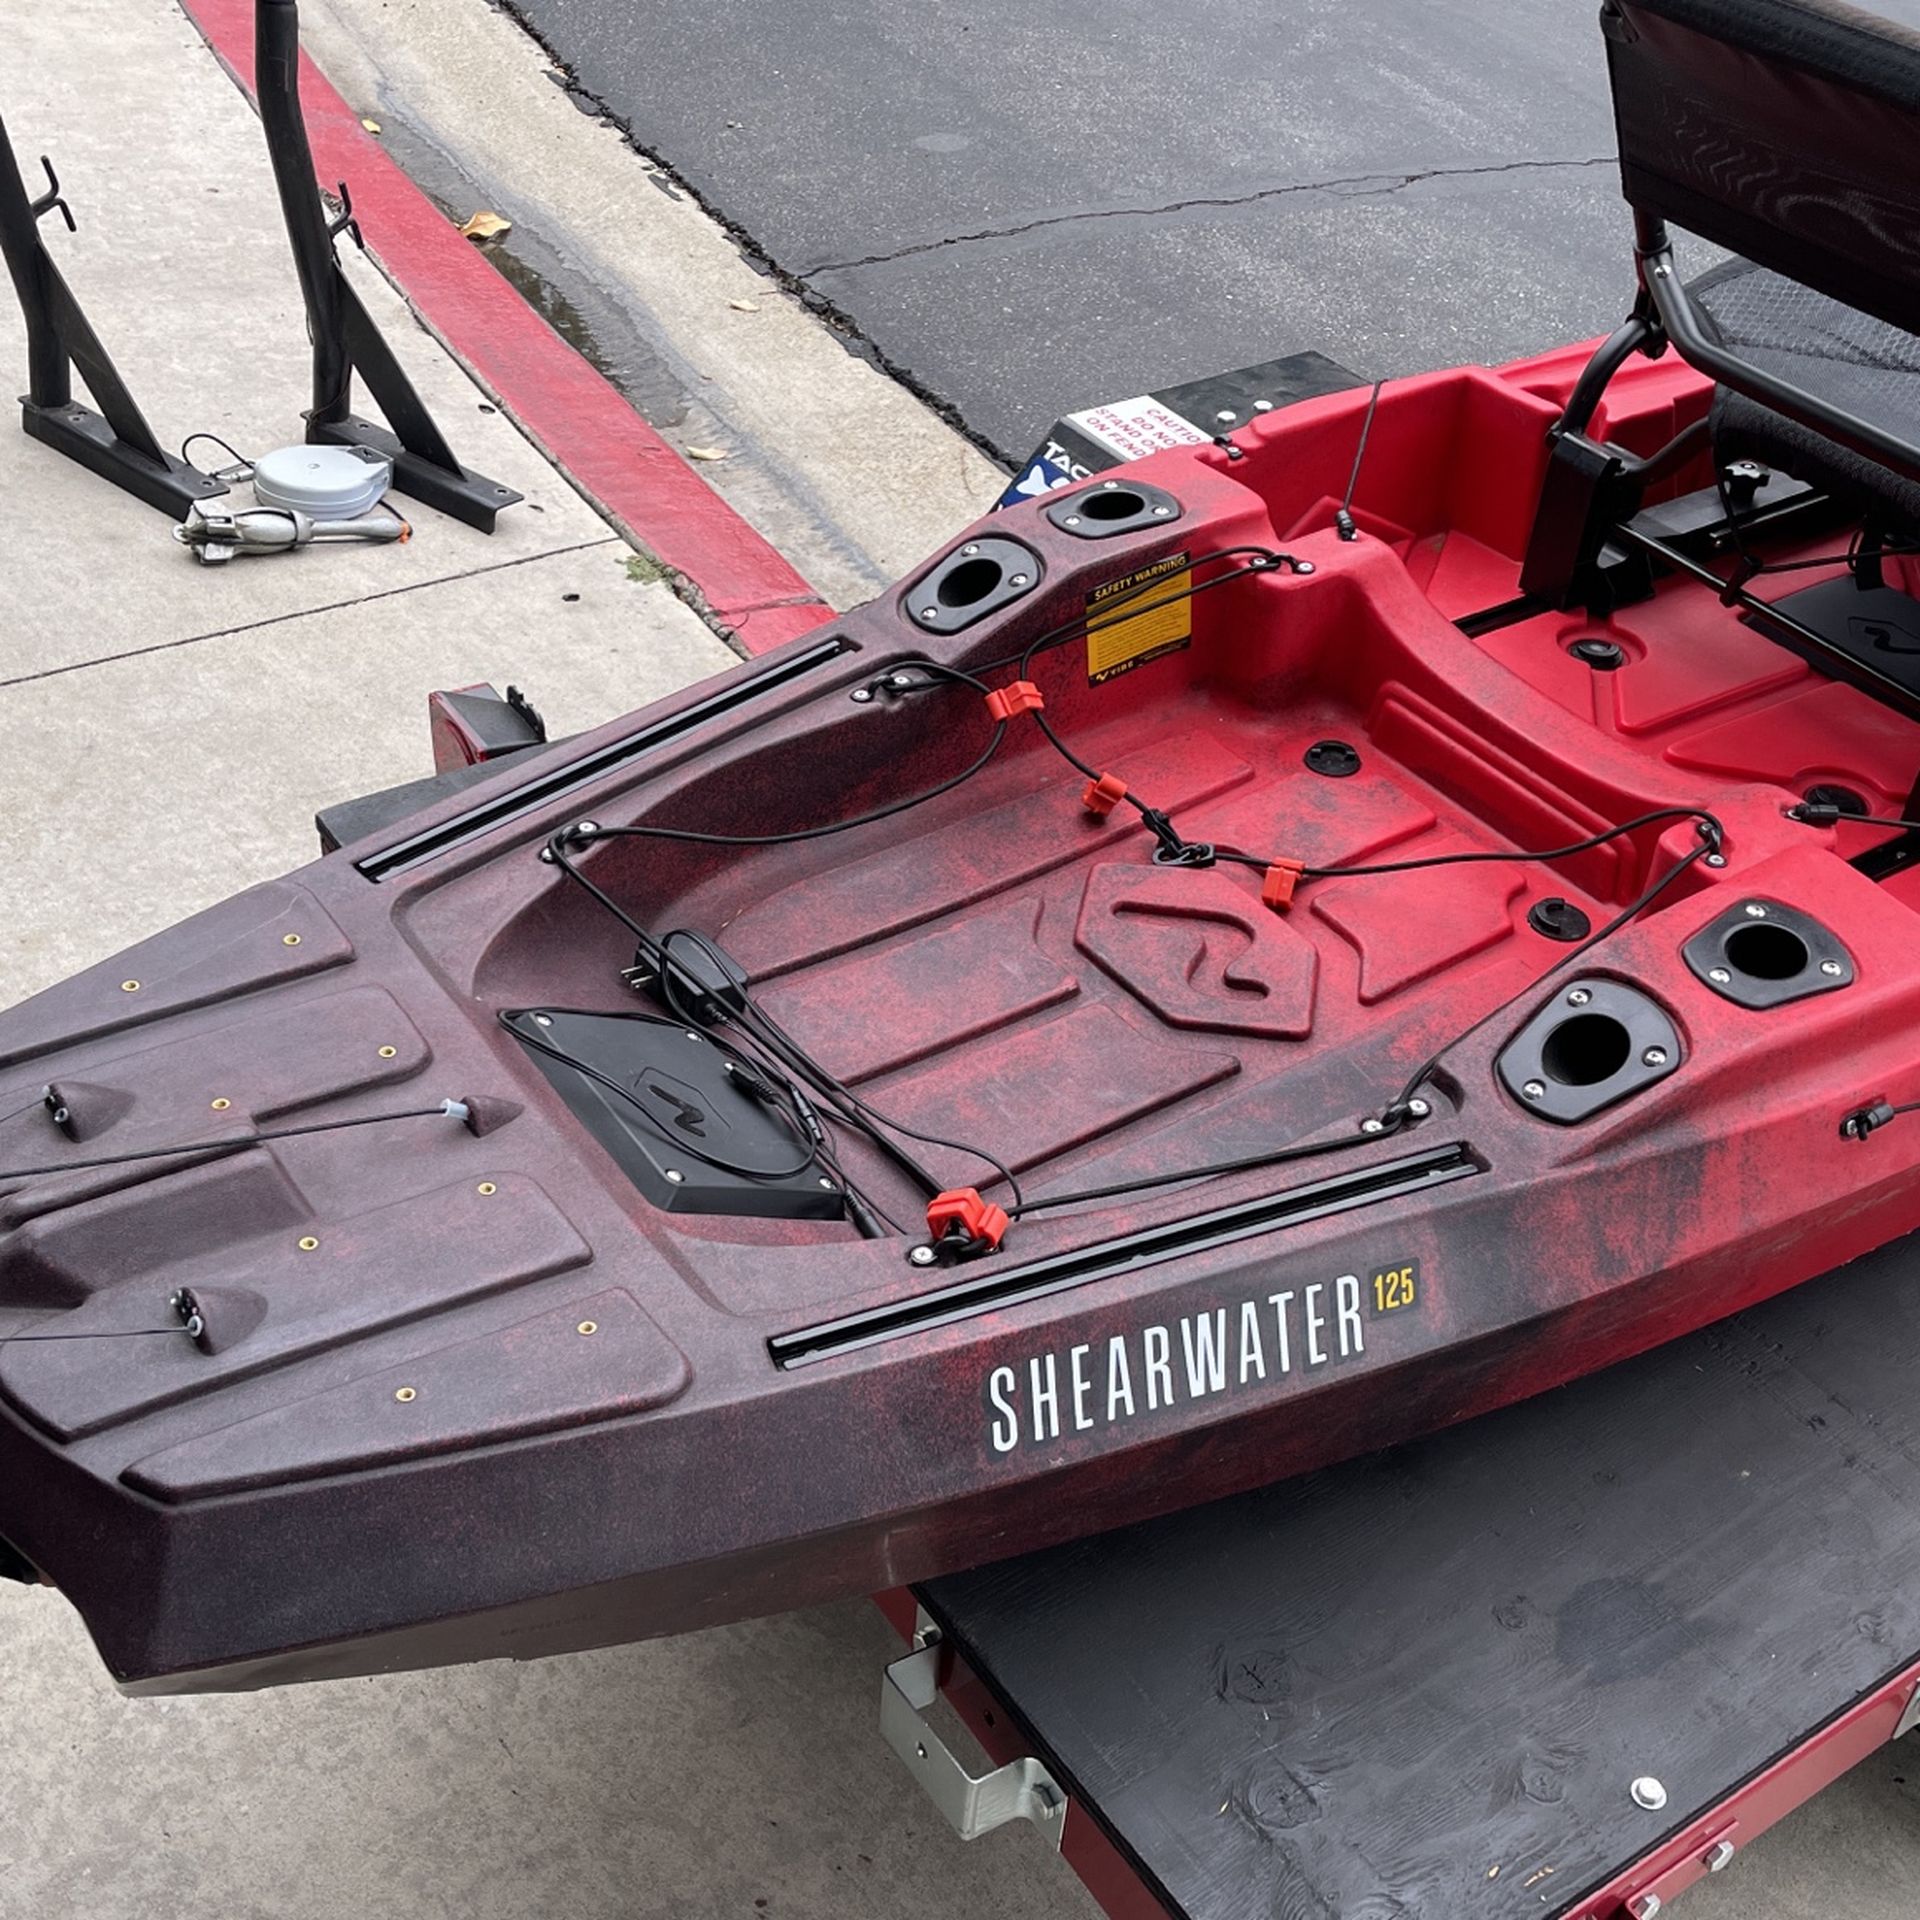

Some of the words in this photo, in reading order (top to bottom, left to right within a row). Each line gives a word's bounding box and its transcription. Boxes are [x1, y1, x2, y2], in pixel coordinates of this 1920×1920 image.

[1086, 417, 1111, 432] ON
[1096, 408, 1142, 438] STAND
[1131, 416, 1155, 431] DO
[1094, 576, 1132, 601] SAFETY
[1134, 556, 1186, 582] WARNING
[989, 1275, 1365, 1452] SHEARWATER
[1374, 1267, 1415, 1312] 125
